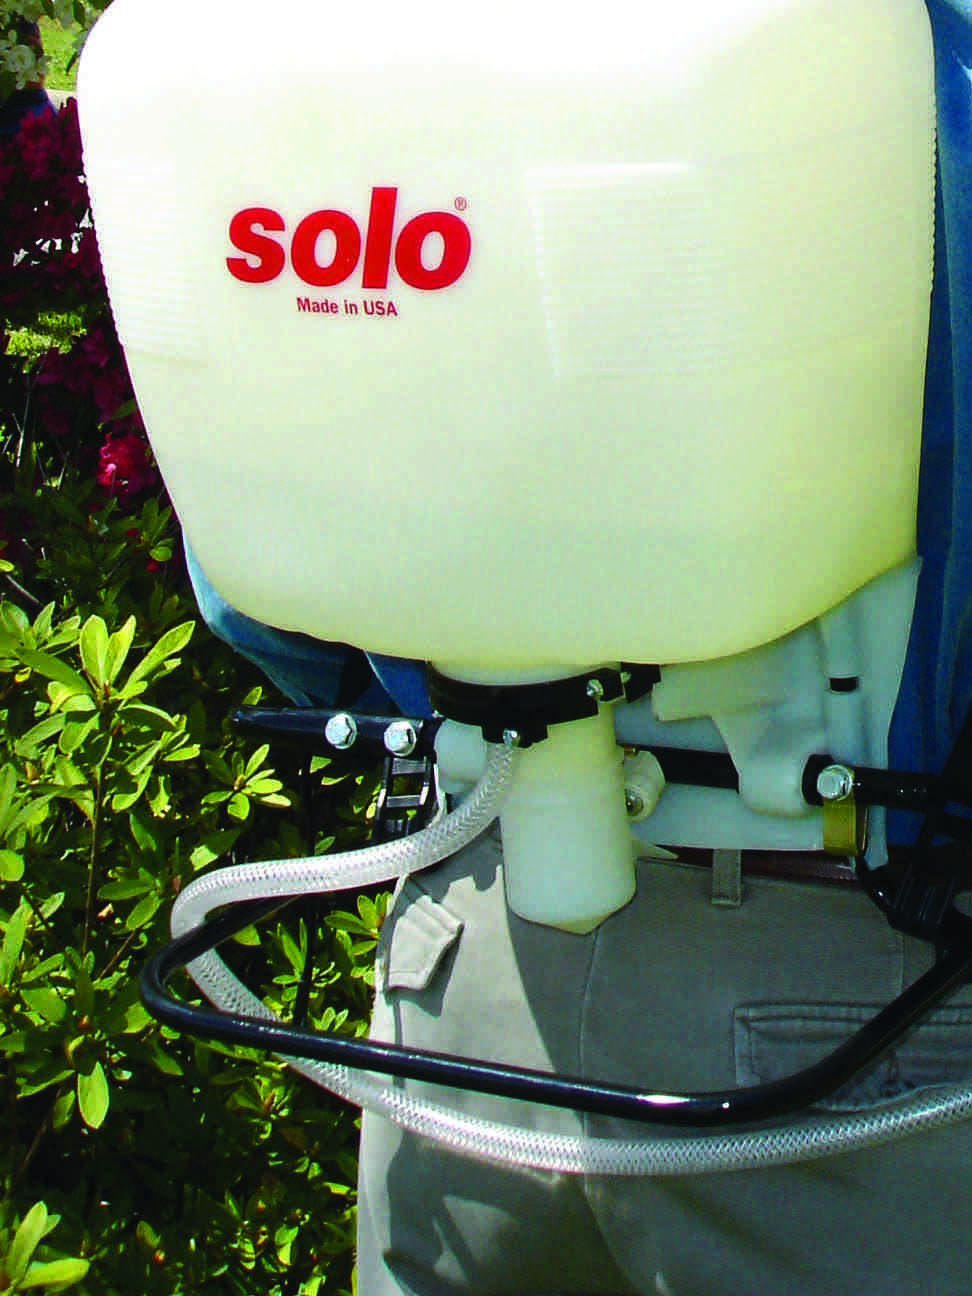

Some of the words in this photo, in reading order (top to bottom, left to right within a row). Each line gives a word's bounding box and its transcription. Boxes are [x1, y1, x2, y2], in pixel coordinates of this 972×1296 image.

[297, 297, 339, 314] Made
[345, 300, 358, 315] in
[363, 301, 398, 316] USA
